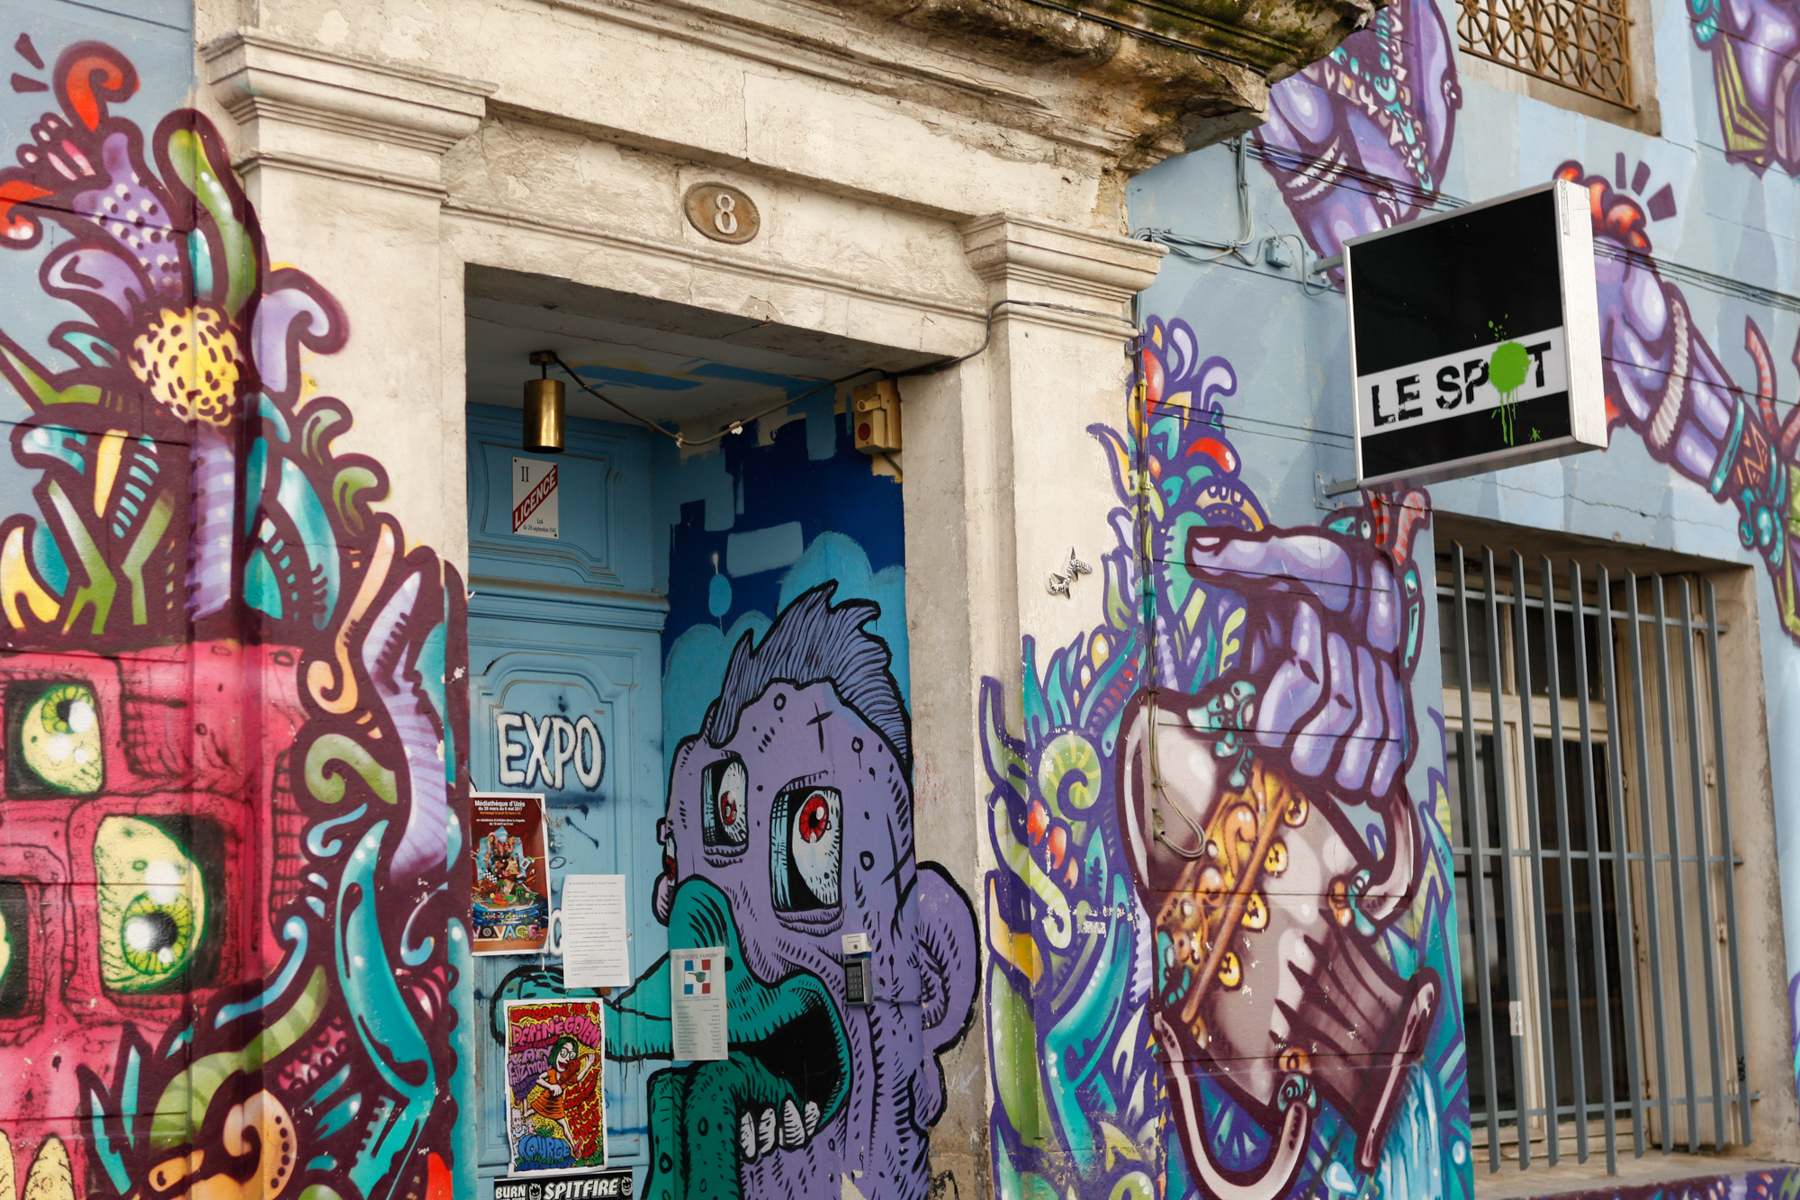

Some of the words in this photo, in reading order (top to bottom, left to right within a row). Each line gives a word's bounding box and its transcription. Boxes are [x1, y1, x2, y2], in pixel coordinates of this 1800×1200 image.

[714, 194, 738, 234] 8
[1371, 374, 1423, 427] LE
[515, 467, 557, 529] LICENCE
[495, 712, 606, 792] EXPO
[474, 800, 508, 808] Médiathèque
[535, 1006, 550, 1021] 29
[495, 1185, 526, 1198] BURN
[543, 1177, 620, 1200] SPITFIRE
